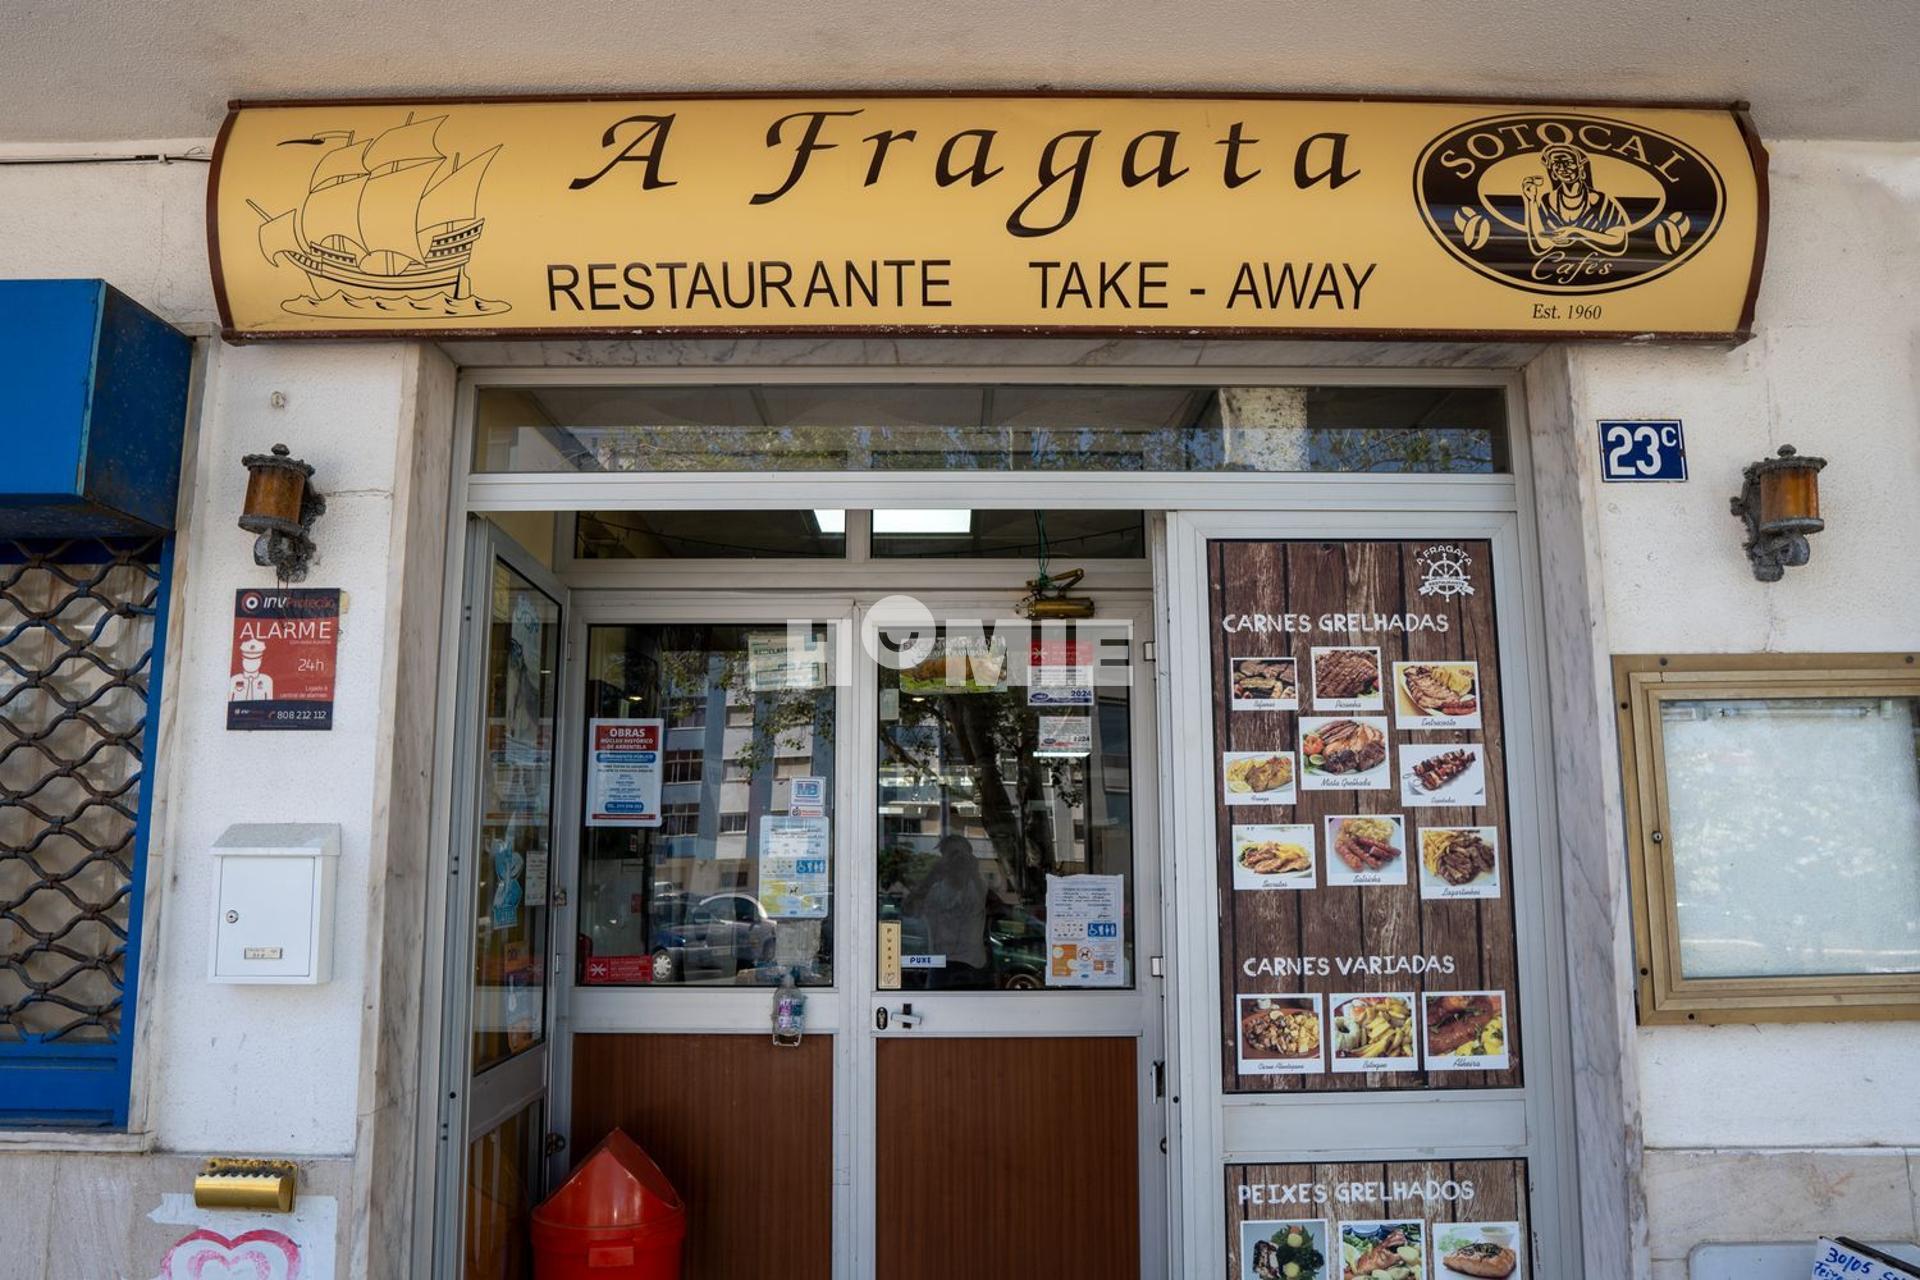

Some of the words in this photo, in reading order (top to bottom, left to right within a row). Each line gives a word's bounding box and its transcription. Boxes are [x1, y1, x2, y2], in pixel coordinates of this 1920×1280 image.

[1440, 122, 1686, 184] SOTOCAL
[568, 112, 678, 191] A
[748, 107, 1361, 238] Fragata
[1531, 251, 1614, 284] Cafés
[547, 260, 952, 311] RESTAURANTE
[1028, 260, 1170, 309] TAKE
[1226, 261, 1378, 310] AWAY
[1532, 303, 1561, 320] Est.
[1567, 304, 1602, 321] 1960
[1423, 544, 1473, 567] FRAGATA
[239, 621, 332, 640] ALARME
[1222, 613, 1311, 633] CARNES
[1318, 612, 1449, 634] GRELHADAS
[297, 658, 326, 672] 24h
[610, 728, 646, 738] OBRAS
[1243, 957, 1330, 977] CARNES
[1335, 955, 1456, 976] VARIADAS
[1238, 1182, 1328, 1205] PEIXES
[1334, 1179, 1475, 1203] GRELHADOS
[1824, 1247, 1874, 1275] 30/05
